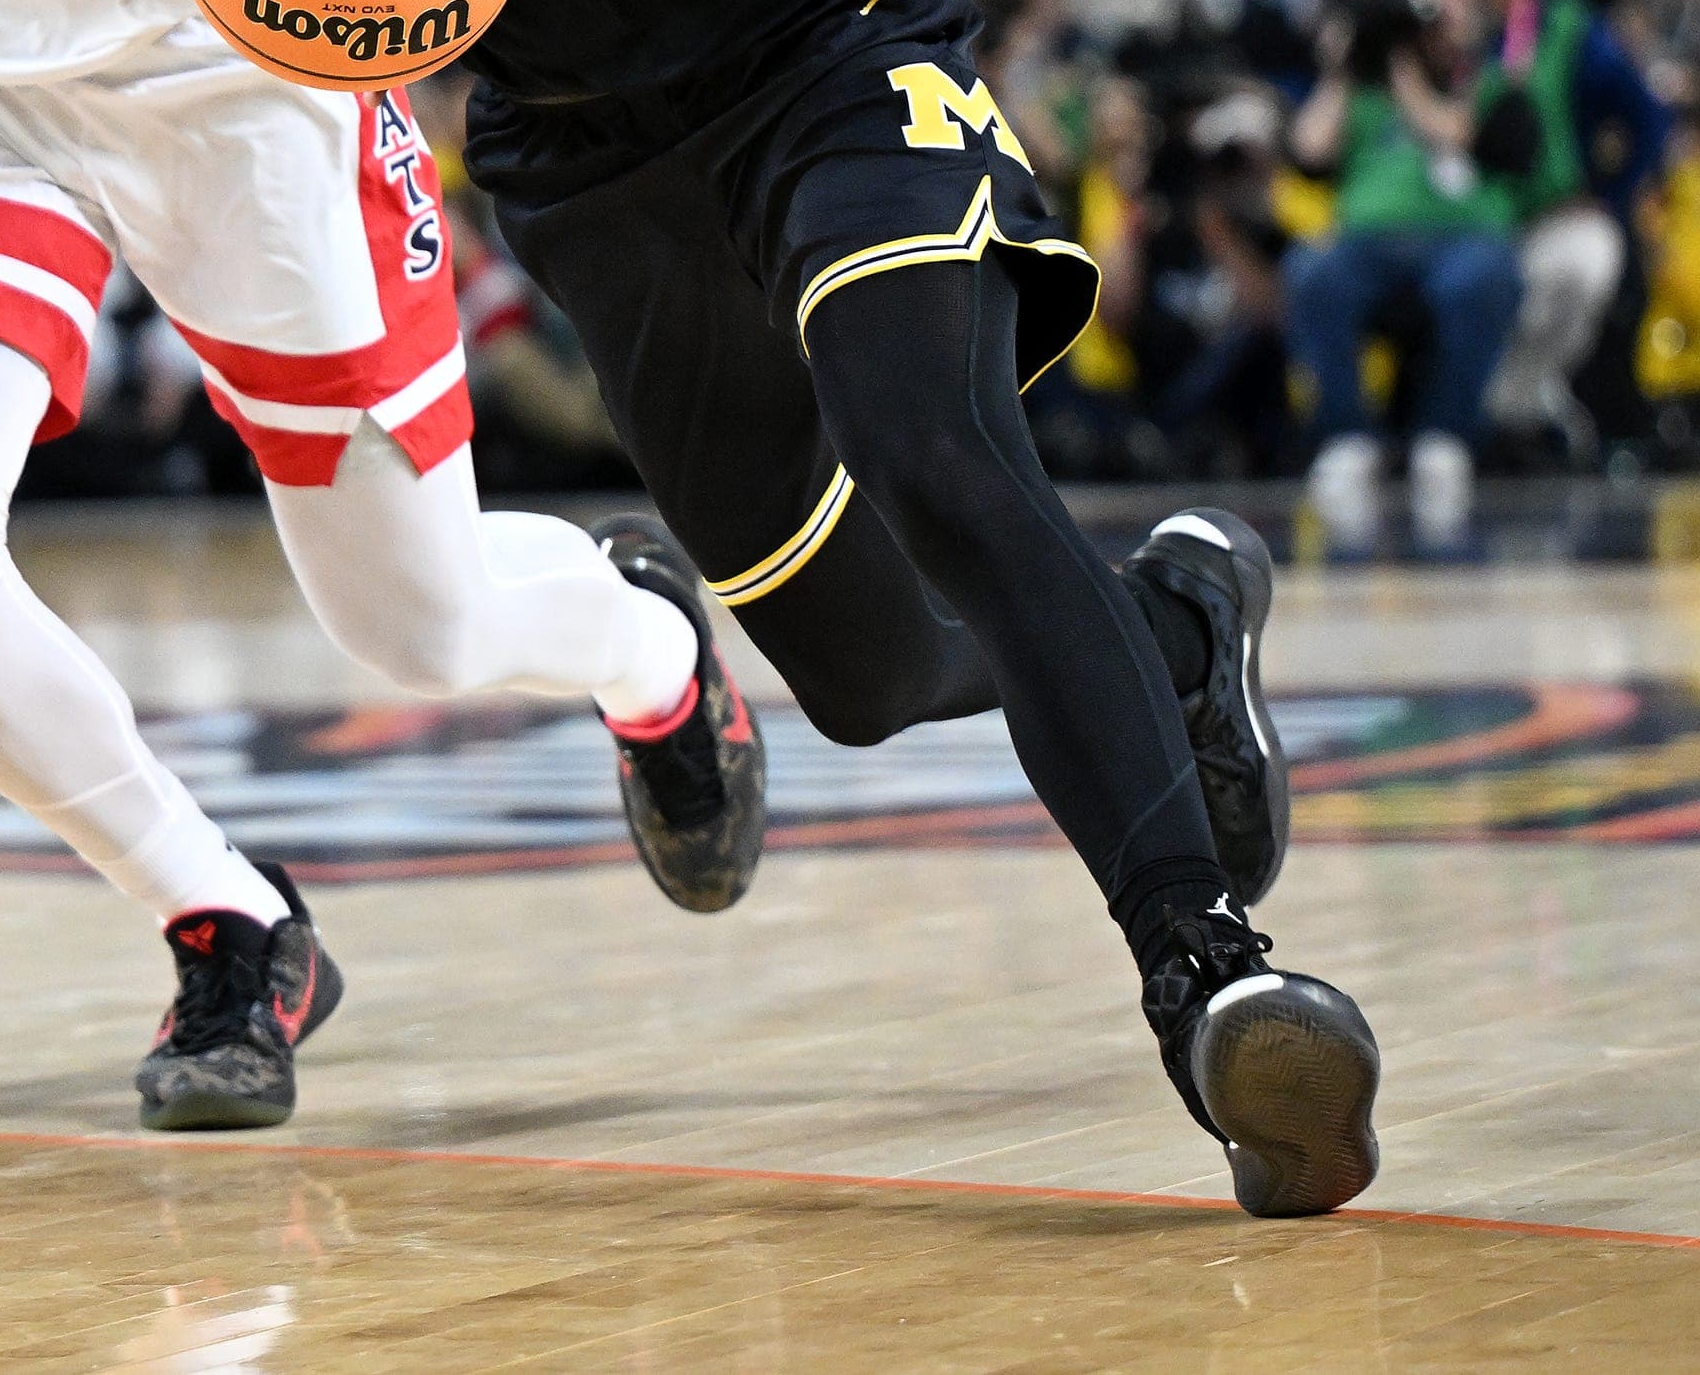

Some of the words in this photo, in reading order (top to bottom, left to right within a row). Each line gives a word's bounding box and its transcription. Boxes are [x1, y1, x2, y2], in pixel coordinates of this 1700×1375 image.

[321, 3, 356, 14] NXT
[362, 4, 396, 14] EVO
[886, 61, 1034, 177] M
